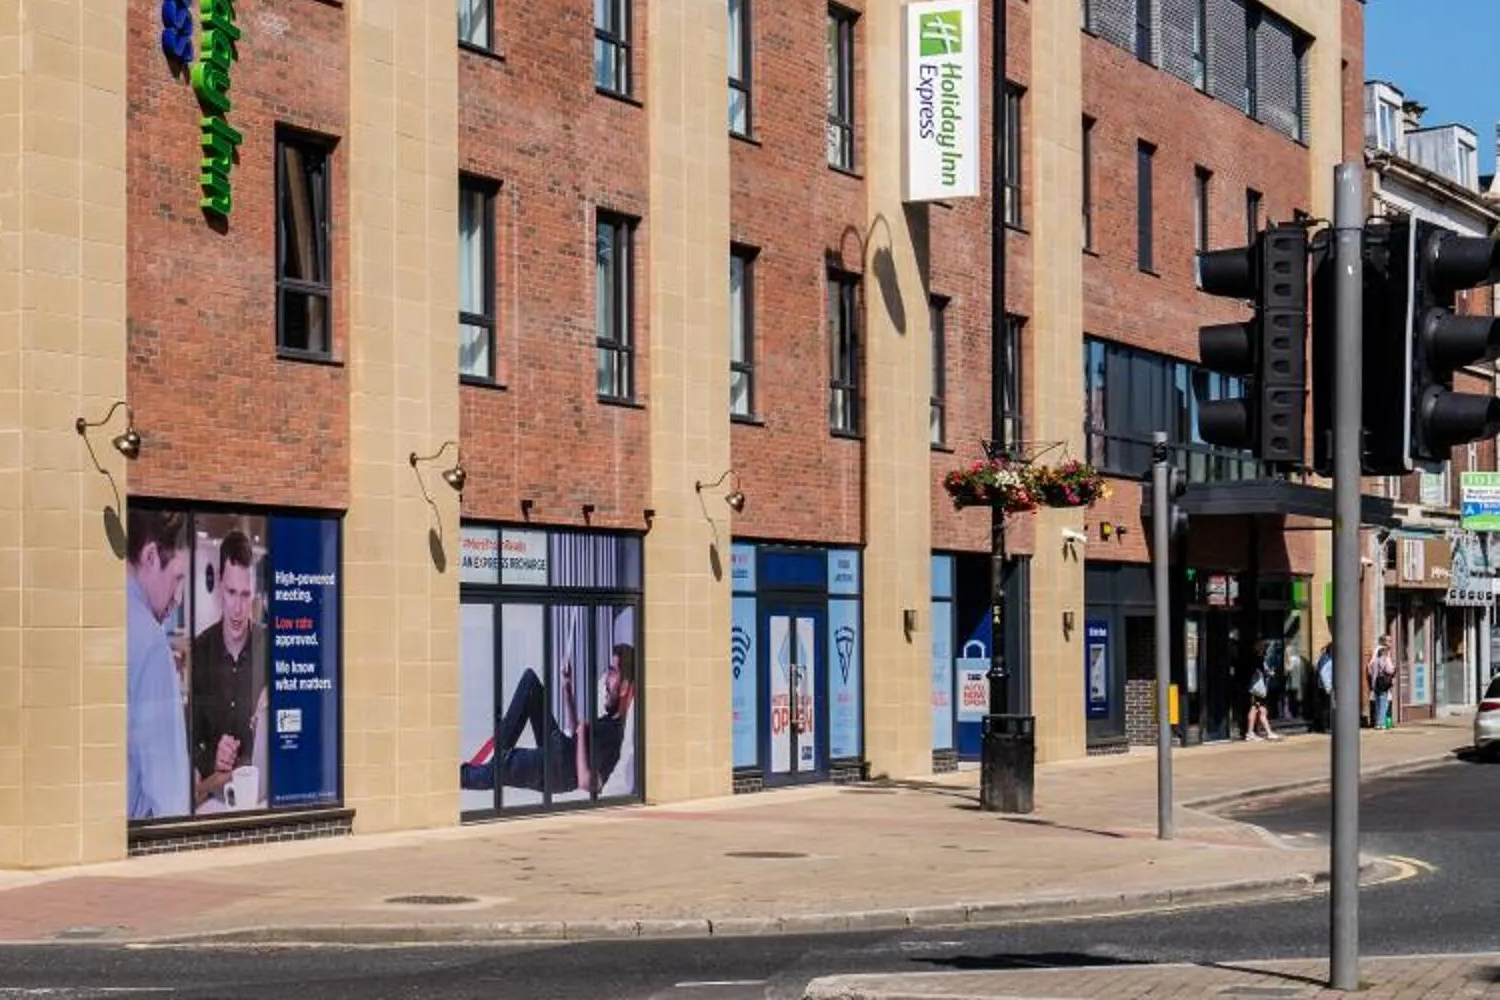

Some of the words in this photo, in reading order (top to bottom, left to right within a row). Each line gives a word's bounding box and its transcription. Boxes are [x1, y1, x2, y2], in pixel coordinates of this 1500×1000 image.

[915, 63, 938, 140] Express
[935, 61, 963, 149] Holiday
[199, 116, 244, 216] Inn
[941, 151, 963, 187] Inn
[461, 555, 473, 568] AN
[275, 571, 335, 587] High-powered
[275, 616, 293, 629] Low
[275, 661, 290, 674] We
[291, 661, 315, 674] know
[275, 678, 297, 691] what
